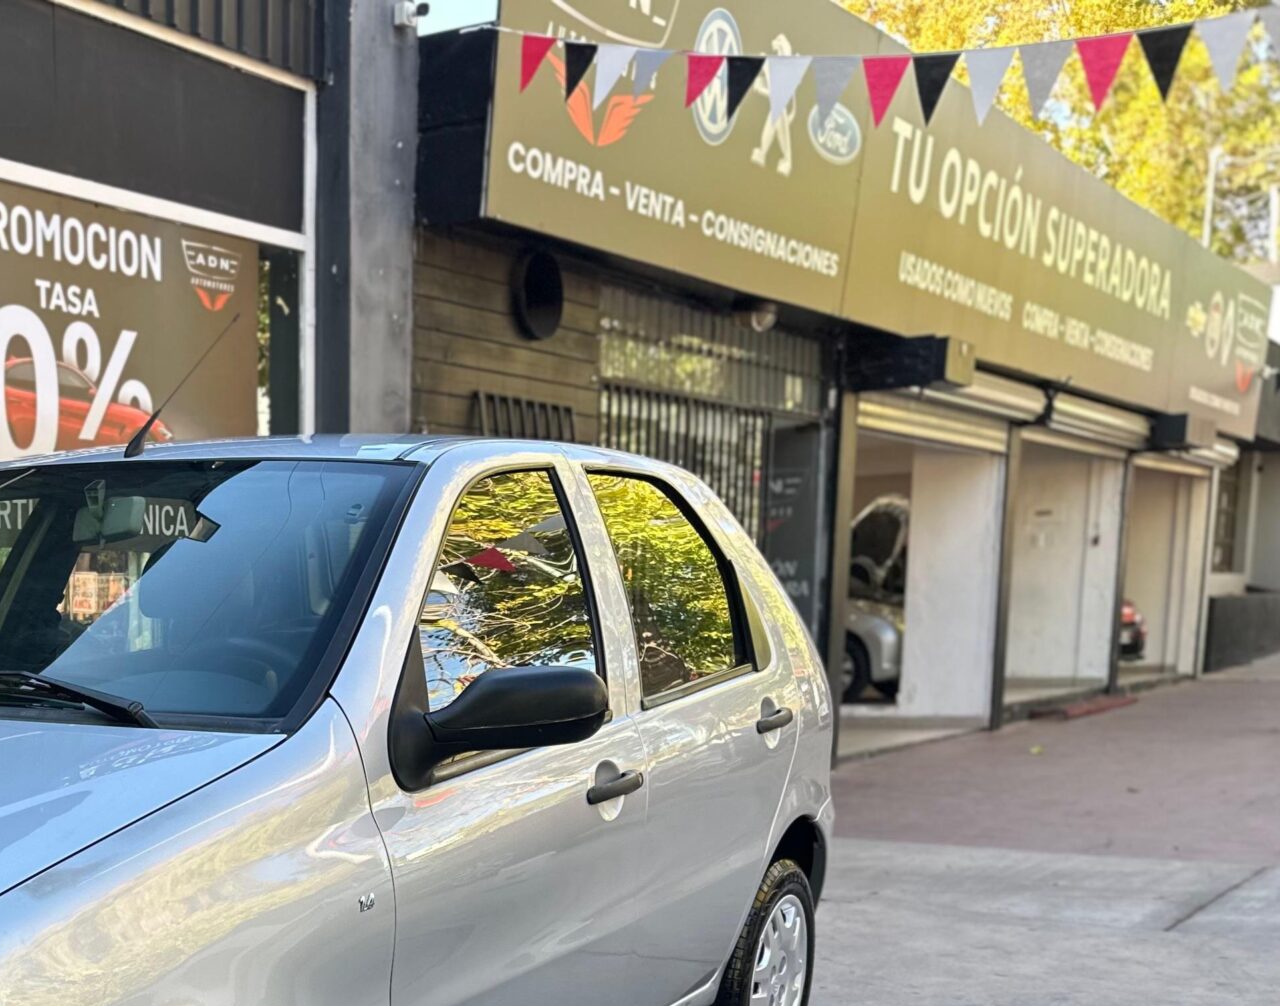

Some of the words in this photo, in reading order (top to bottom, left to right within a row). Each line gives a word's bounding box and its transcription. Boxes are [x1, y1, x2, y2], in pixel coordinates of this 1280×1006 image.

[507, 142, 605, 201] COMPRA
[625, 180, 685, 229] VENTA
[701, 210, 839, 277] CONSIGNACIONES
[890, 116, 934, 204] TU
[938, 147, 1042, 259] OPCIÓN
[1042, 206, 1172, 320] SUPERADORA
[35, 278, 100, 318] TASA
[196, 252, 229, 271] ADN
